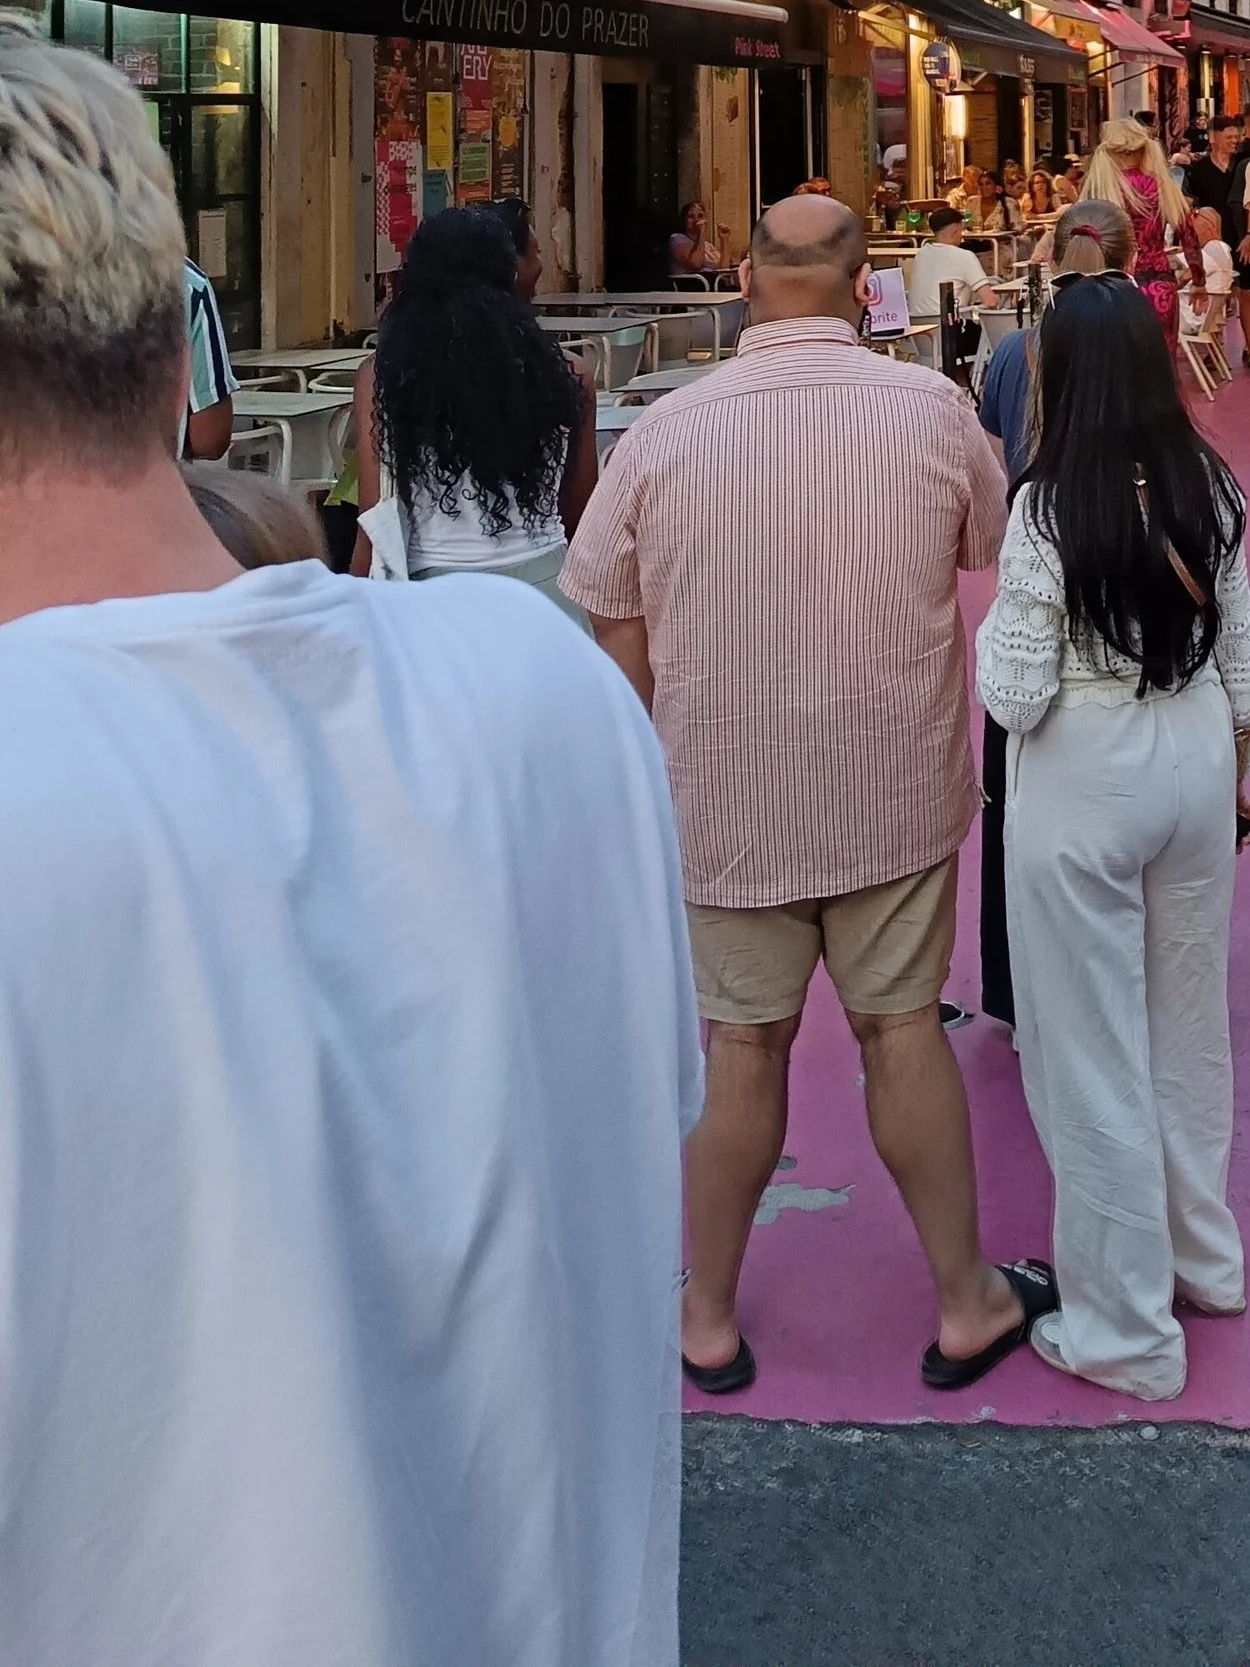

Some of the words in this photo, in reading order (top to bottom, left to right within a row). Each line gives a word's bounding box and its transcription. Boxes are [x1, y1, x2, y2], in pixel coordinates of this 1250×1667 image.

[539, 1, 571, 39] DO
[582, 7, 649, 48] PRAZER
[755, 39, 780, 58] Street
